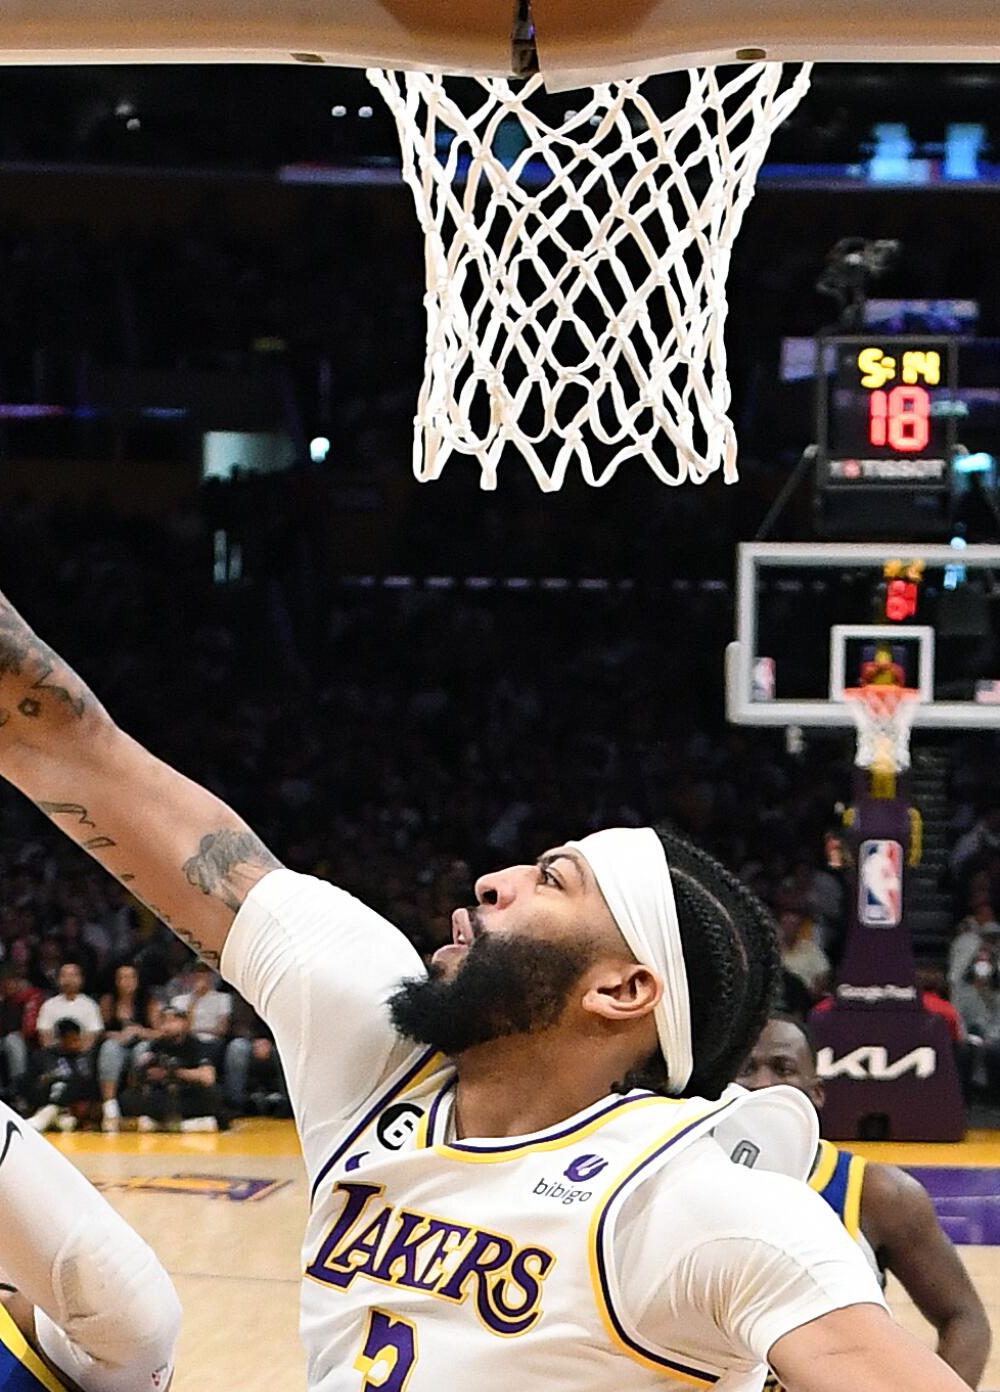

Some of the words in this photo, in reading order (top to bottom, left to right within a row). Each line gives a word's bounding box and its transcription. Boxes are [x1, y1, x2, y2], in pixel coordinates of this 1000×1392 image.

[869, 386, 930, 452] 18
[383, 1110, 416, 1149] 6
[532, 1177, 593, 1205] bibigo
[304, 1180, 556, 1338] LAKERS
